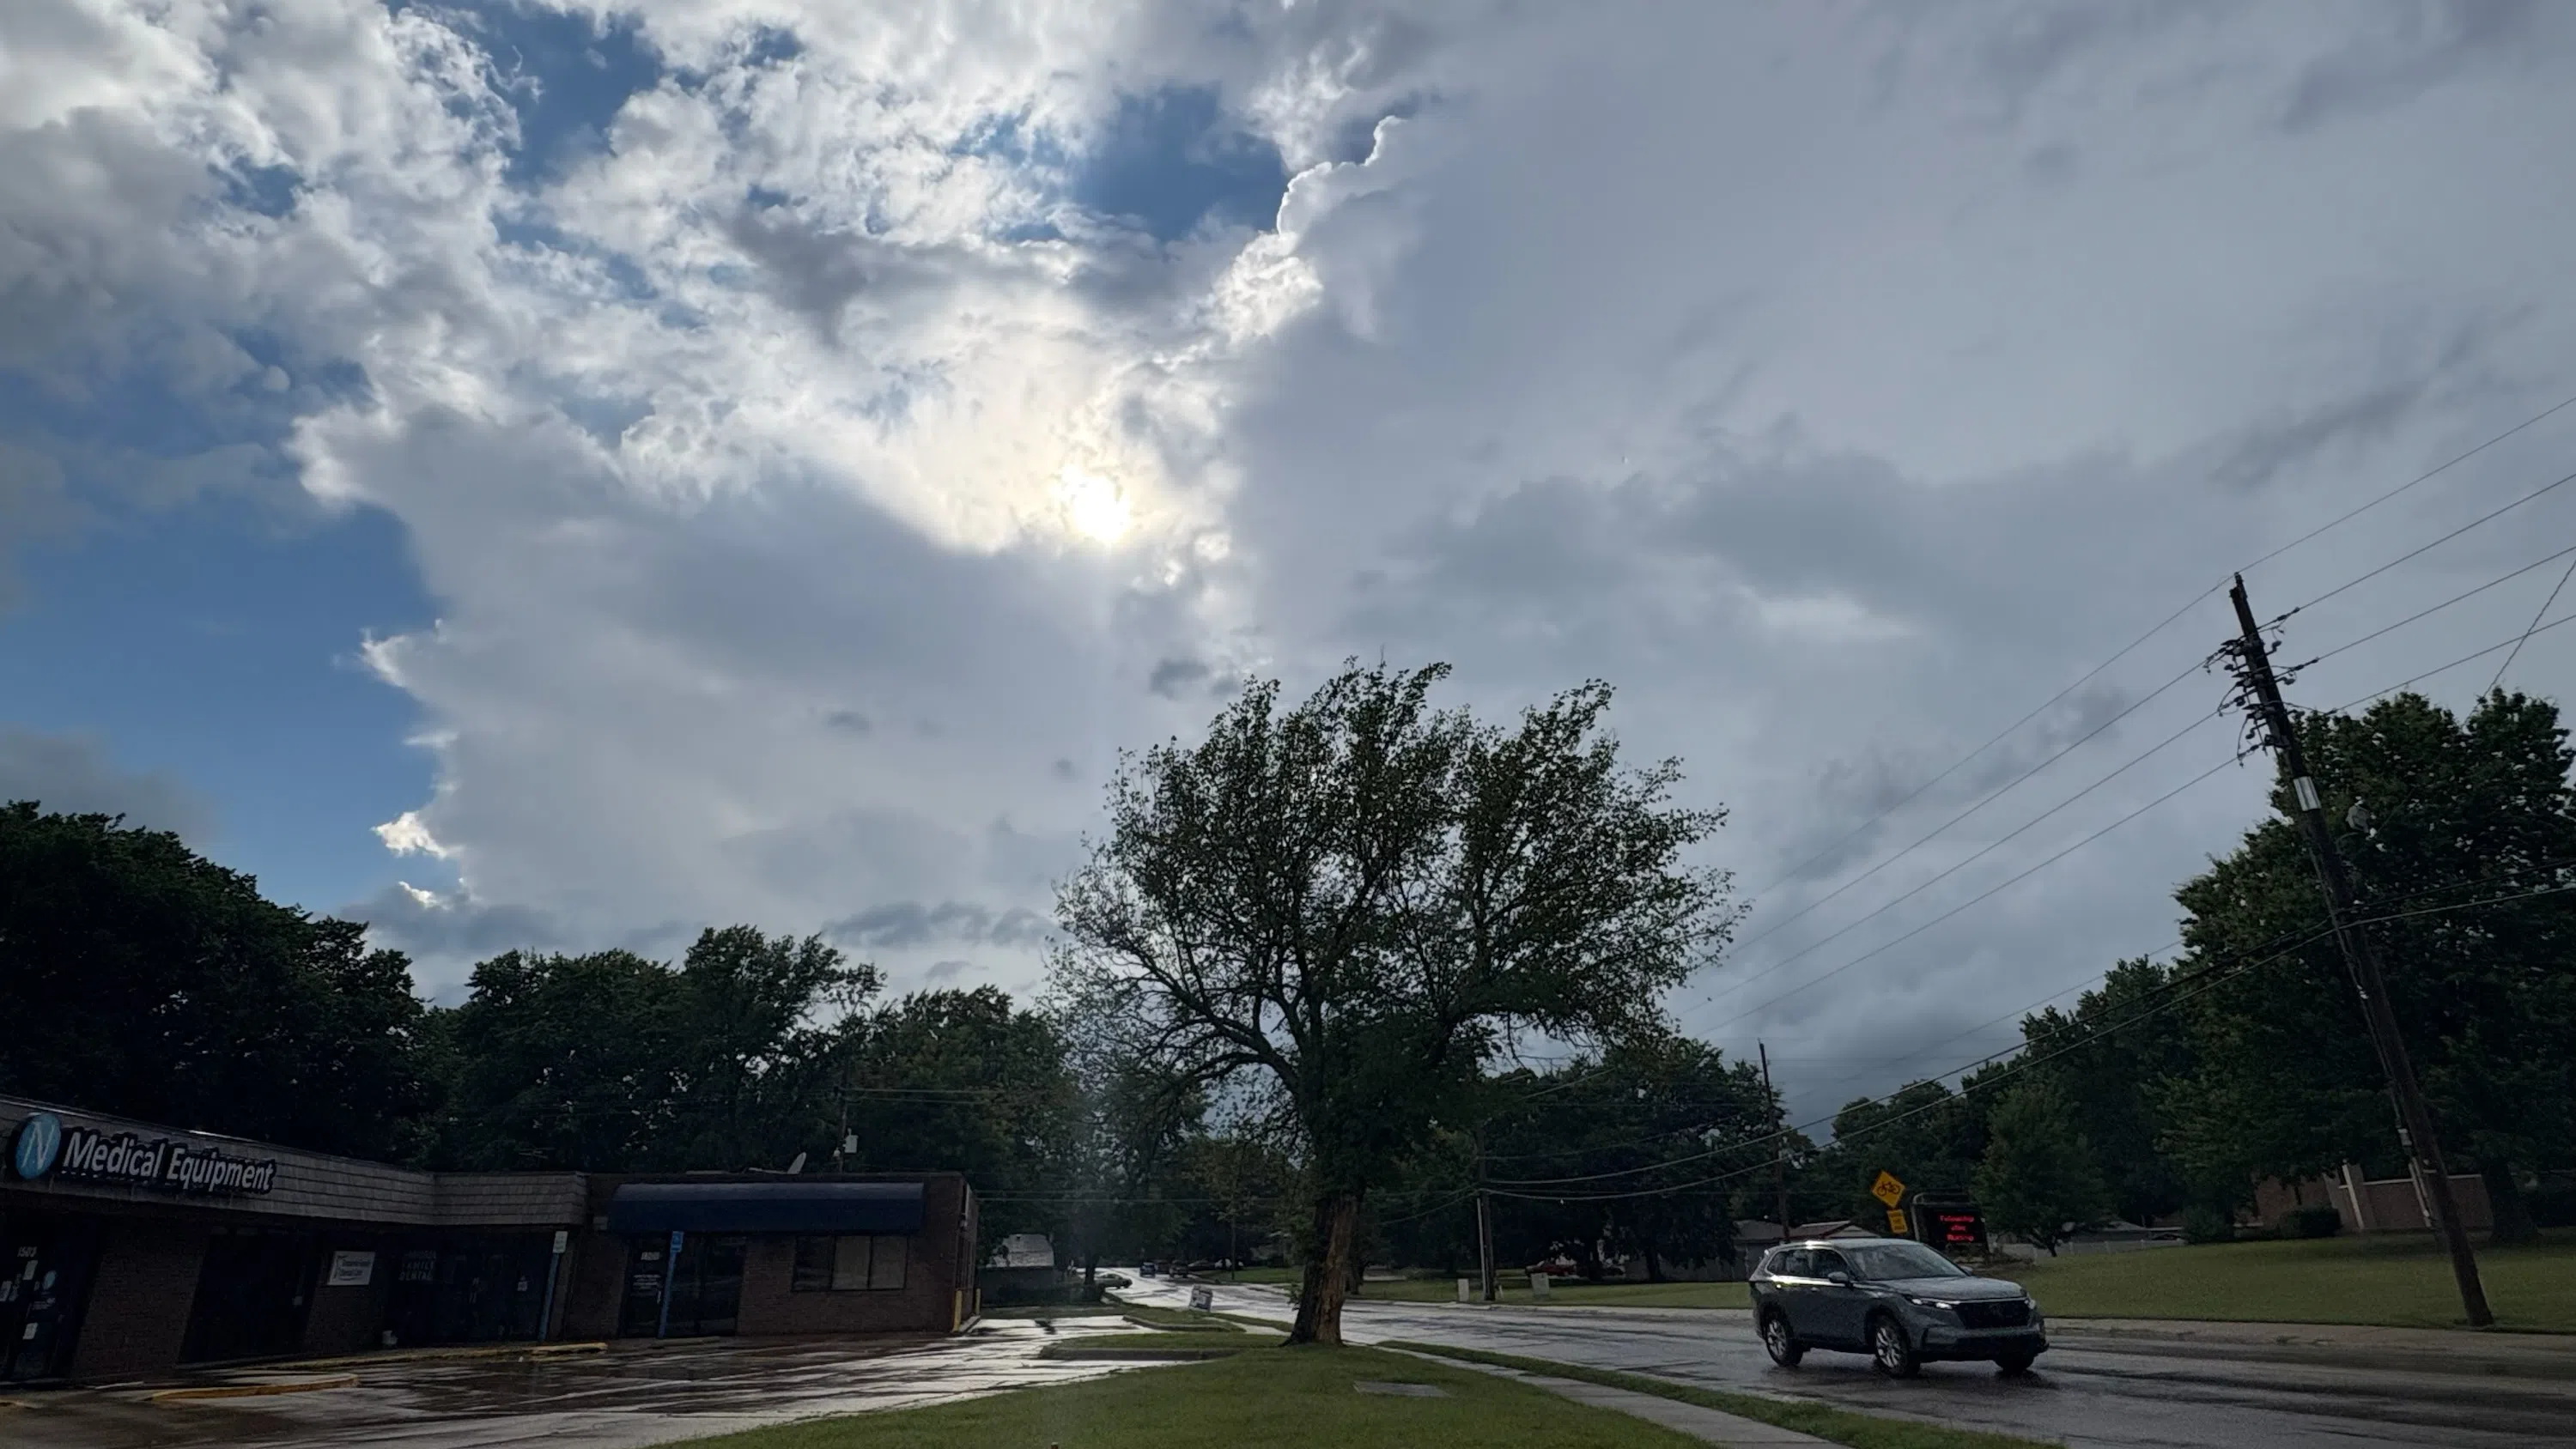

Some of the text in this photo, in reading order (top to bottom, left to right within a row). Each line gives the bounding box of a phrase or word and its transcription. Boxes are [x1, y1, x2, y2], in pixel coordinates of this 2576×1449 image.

[21, 1120, 274, 1191] N Medical Equipment
